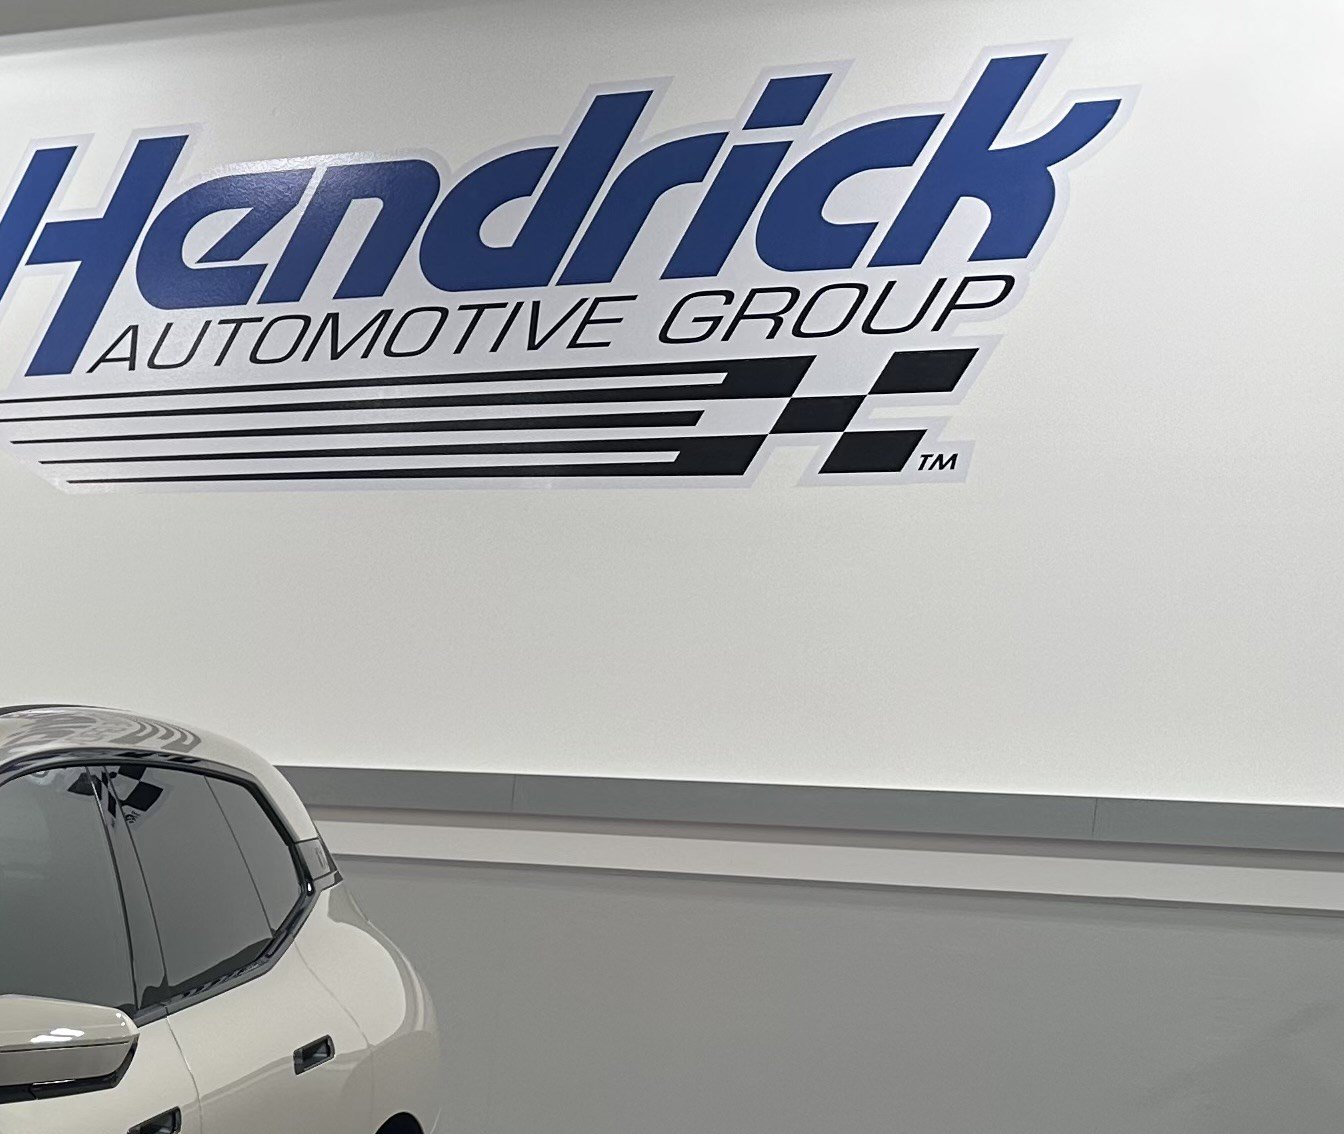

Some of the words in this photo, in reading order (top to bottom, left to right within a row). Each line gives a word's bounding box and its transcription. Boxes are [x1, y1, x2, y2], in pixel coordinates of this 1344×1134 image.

[85, 294, 639, 374] AUTOMOTIVE
[658, 274, 1016, 345] GROUP
[917, 453, 959, 471] TM
